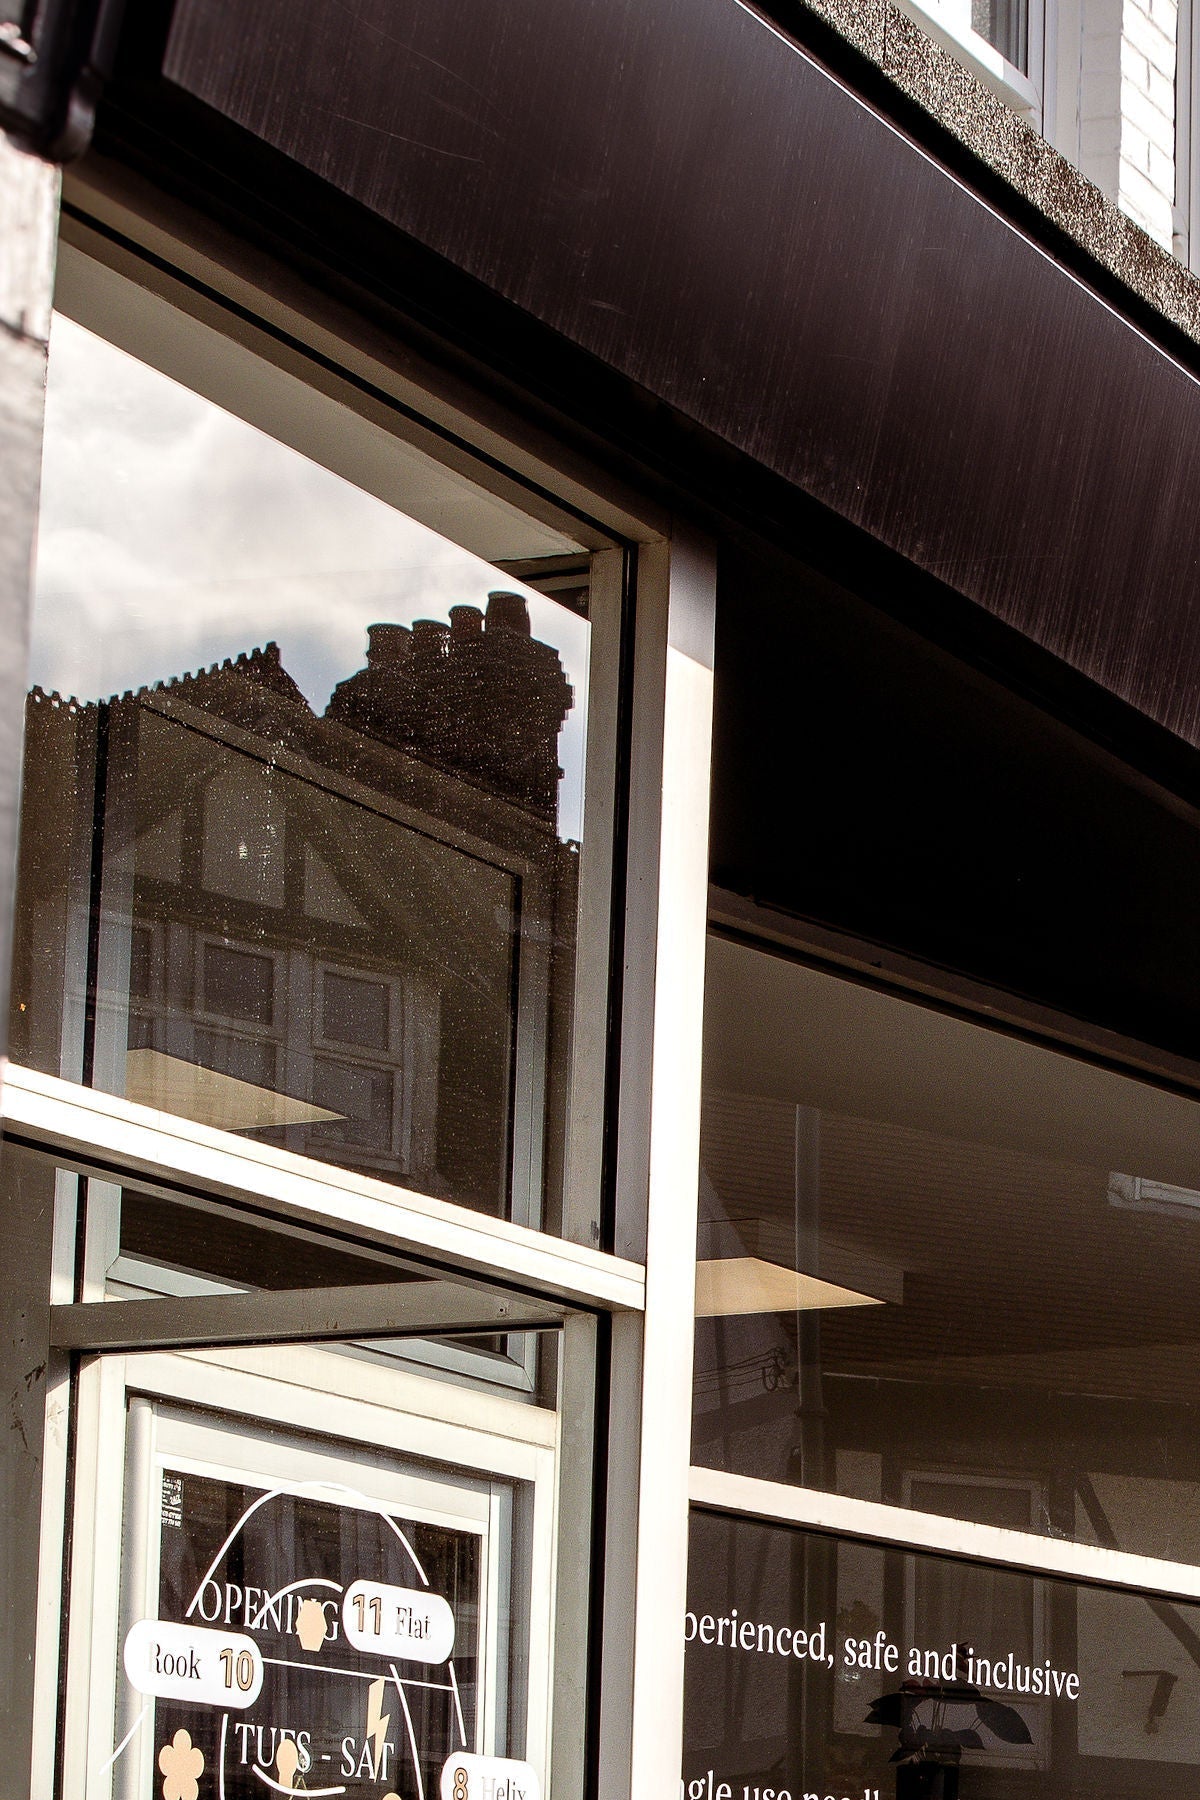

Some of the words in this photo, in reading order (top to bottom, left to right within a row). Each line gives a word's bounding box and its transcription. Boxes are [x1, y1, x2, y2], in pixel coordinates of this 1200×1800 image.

[352, 1593, 382, 1636] 11
[394, 1606, 432, 1641] Flat
[219, 1647, 255, 1692] 10
[844, 1630, 899, 1674] safe
[907, 1639, 959, 1684] and
[966, 1646, 1081, 1700] inclusive
